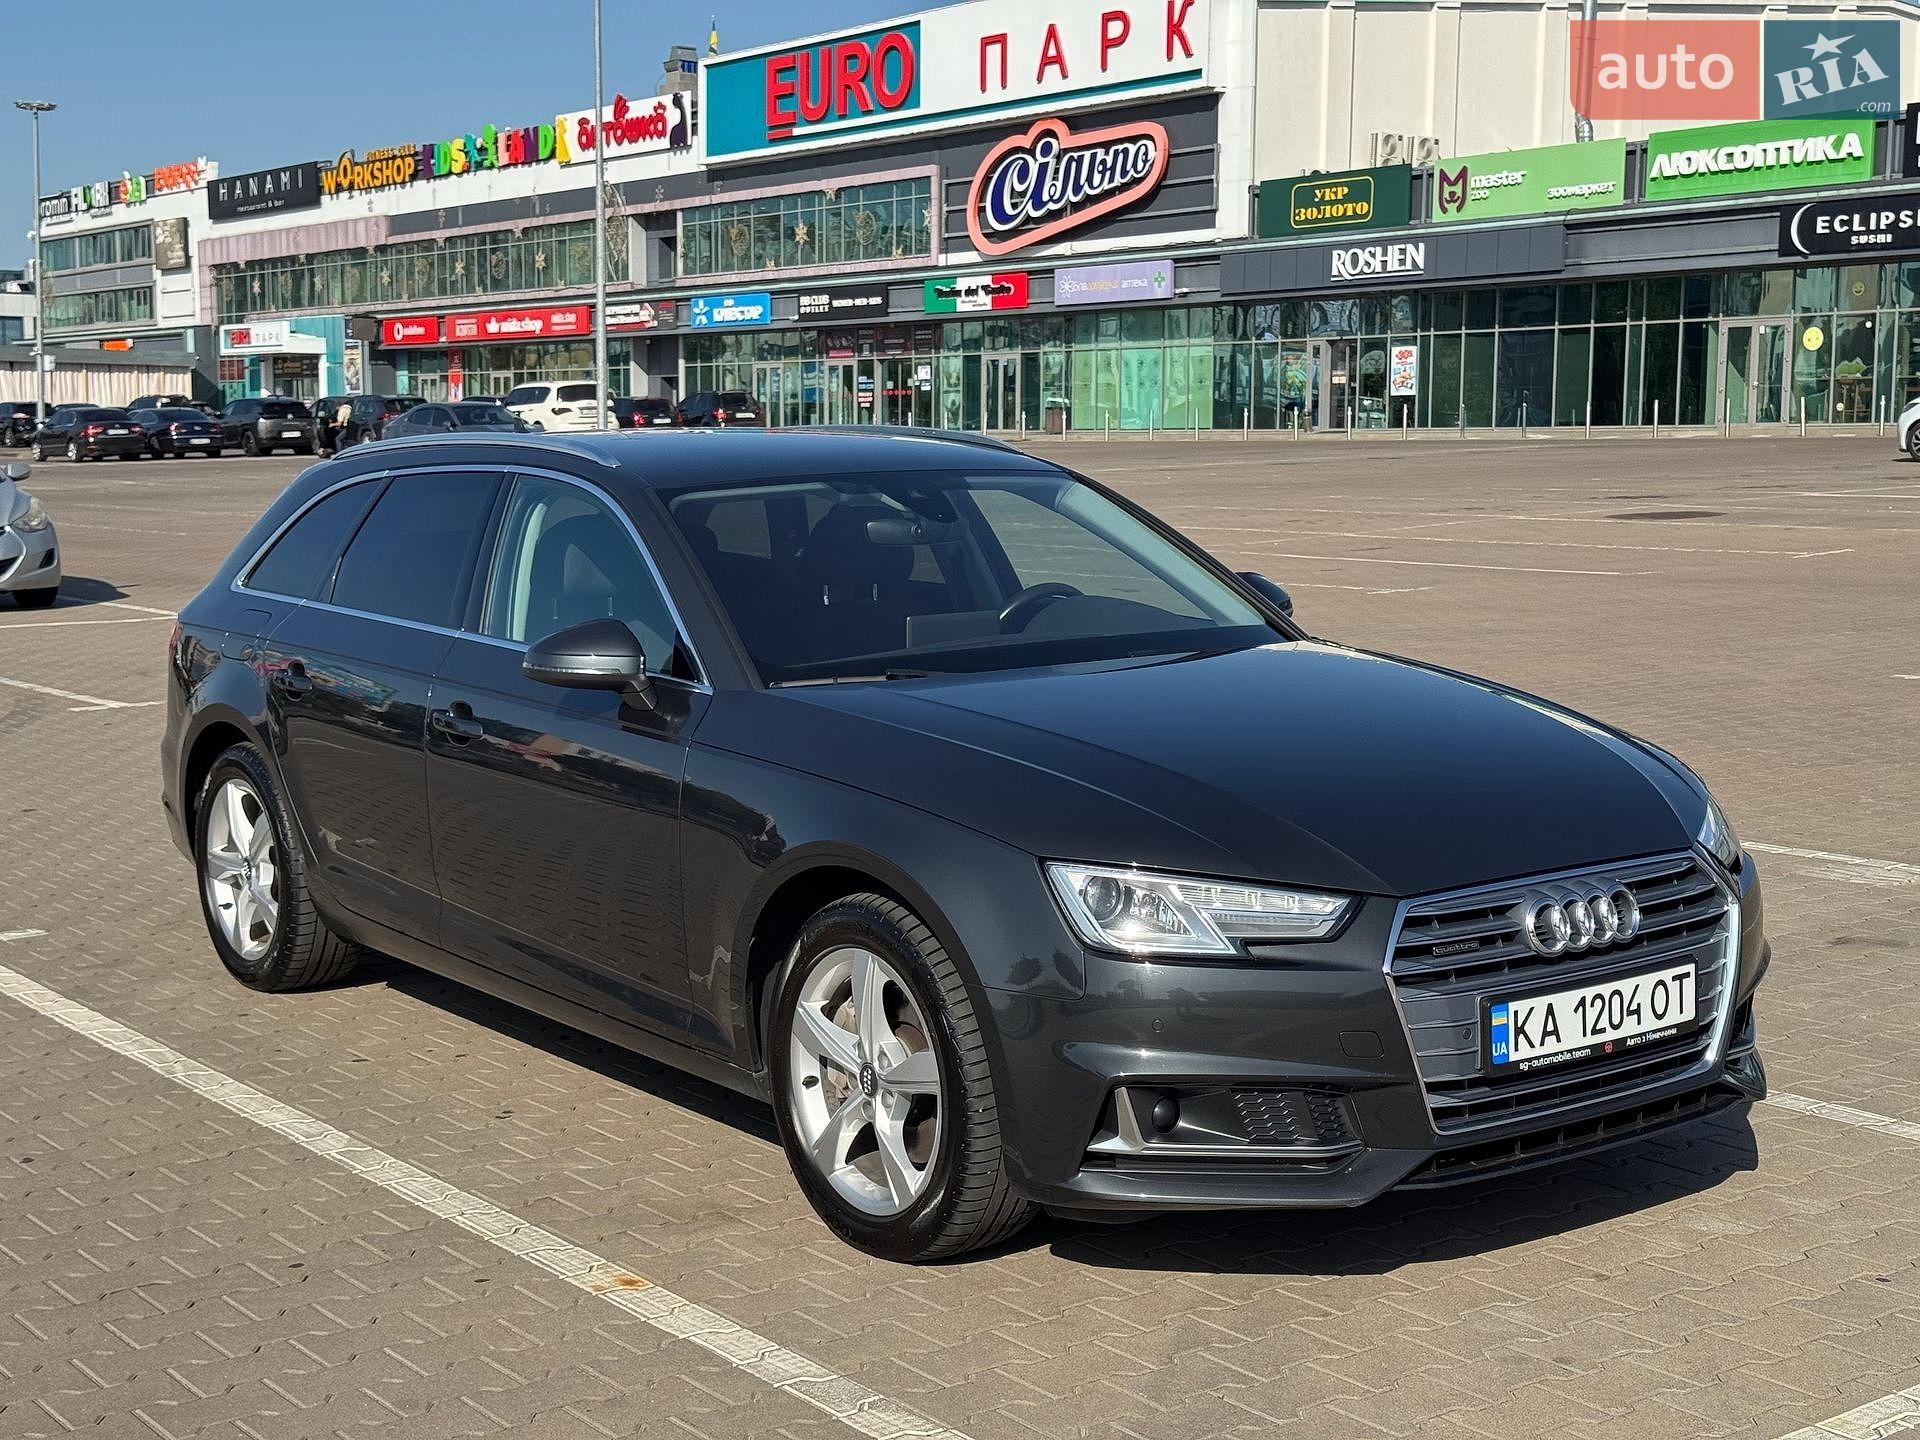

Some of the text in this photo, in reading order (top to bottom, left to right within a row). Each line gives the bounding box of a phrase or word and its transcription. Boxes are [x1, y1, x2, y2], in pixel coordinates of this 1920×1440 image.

[766, 0, 1194, 127] EURO ПАРК
[1650, 132, 1864, 179] ЛЮКСОПТИКА
[219, 168, 303, 201] HANAMI
[321, 156, 415, 195] WORKSHOP
[985, 137, 1157, 231] Сільпо
[1471, 170, 1528, 189] master
[1314, 186, 1349, 202] УКР
[1471, 190, 1490, 200] zoo
[1547, 181, 1616, 200] зоомаркет
[1294, 201, 1369, 221] ЗОЛОТО
[1816, 208, 1920, 234] ECLIPS
[1851, 234, 1893, 244] SUSHI
[1330, 242, 1425, 280] ROSHEN
[1514, 971, 1691, 1052] KA 1204 OT
[1493, 1042, 1508, 1056] UA
[1519, 1047, 1591, 1071] sg-automobile.team
